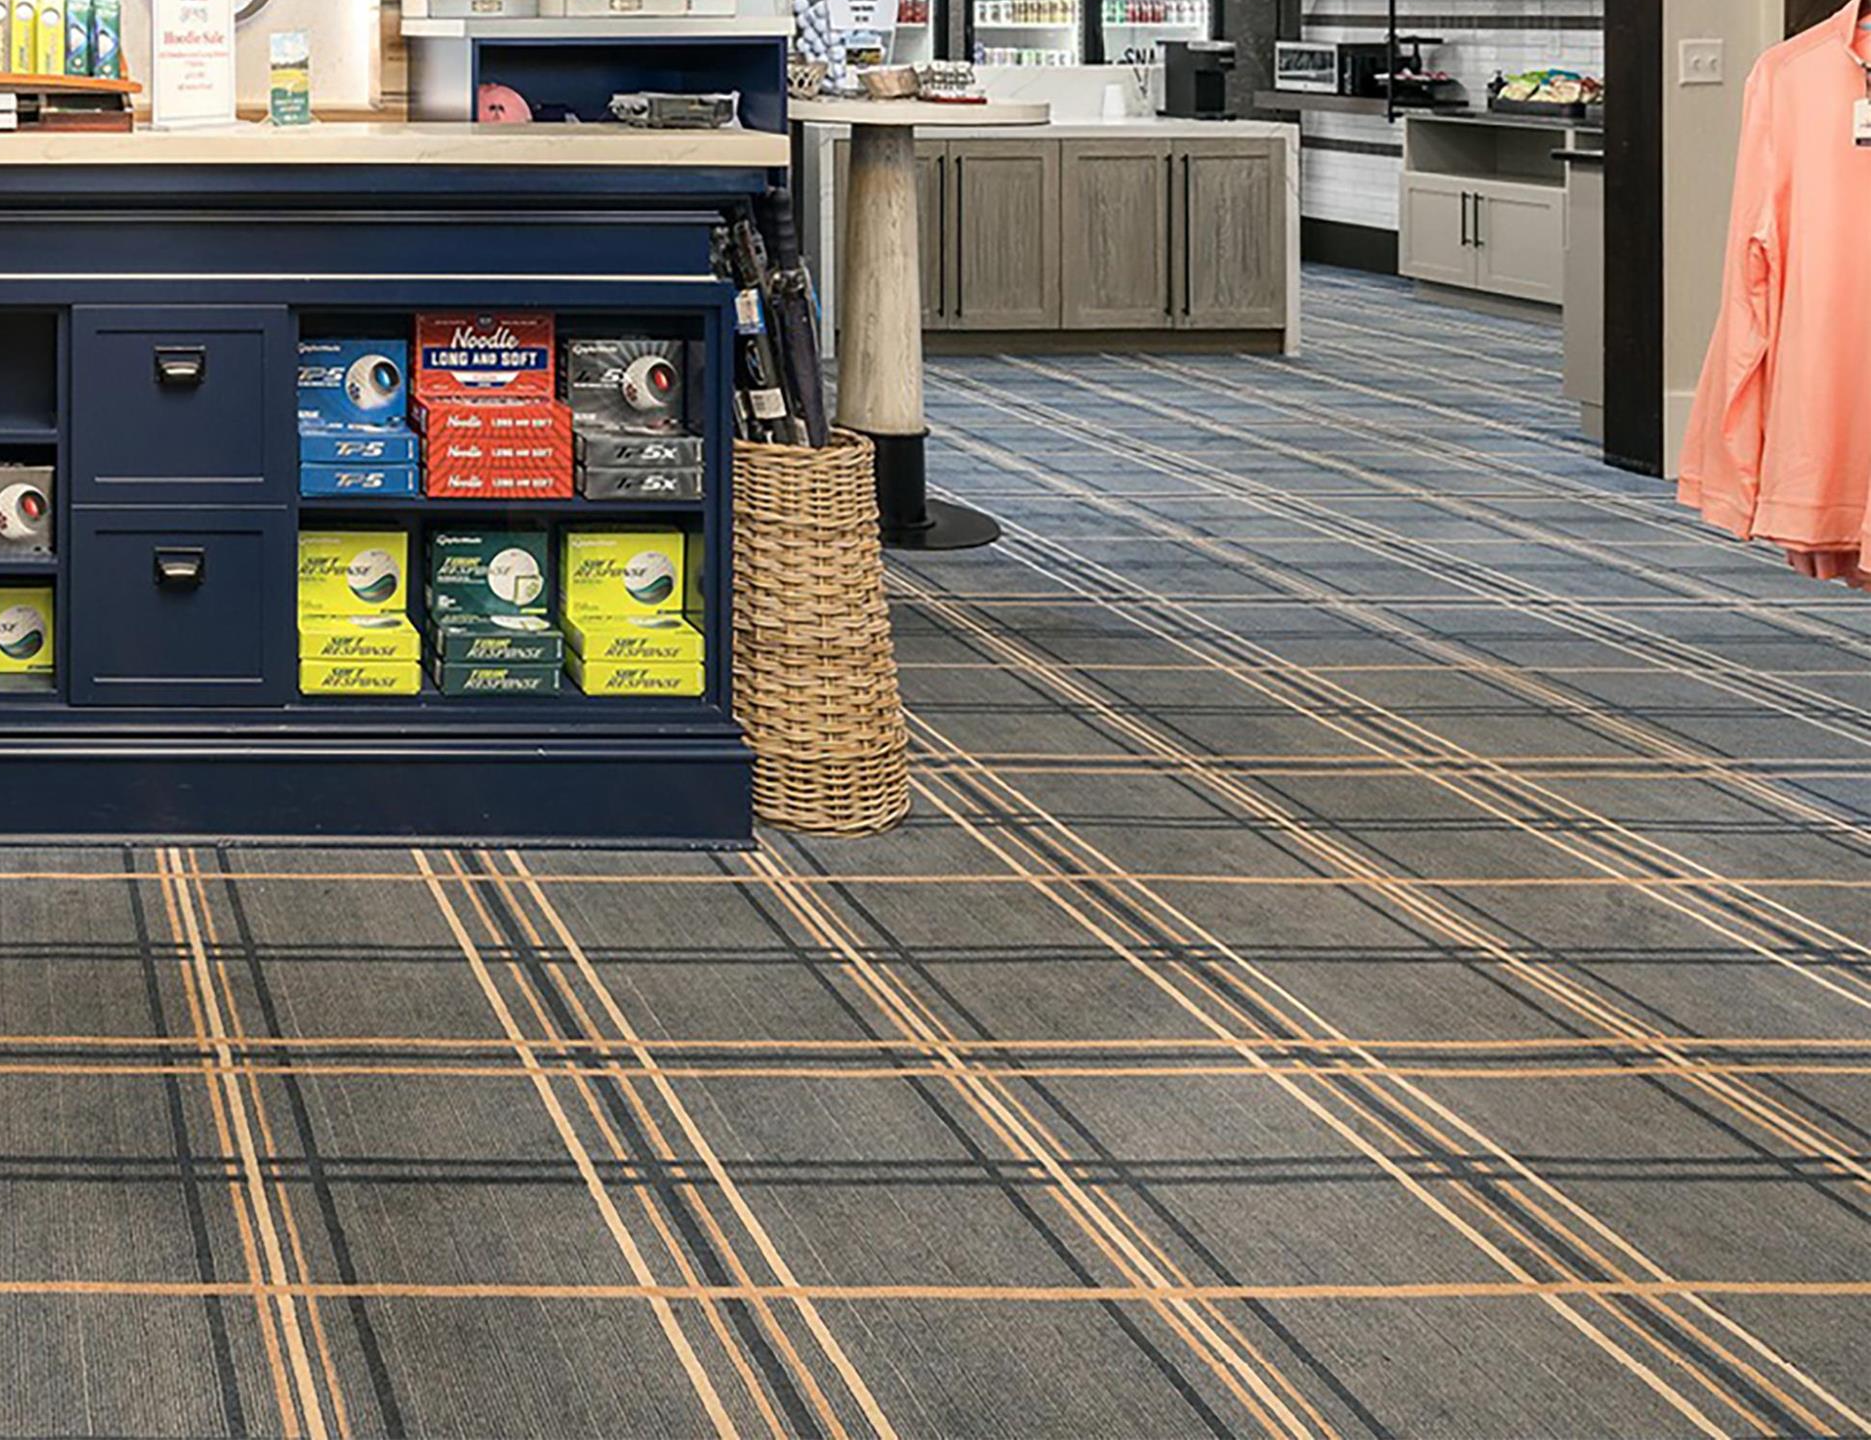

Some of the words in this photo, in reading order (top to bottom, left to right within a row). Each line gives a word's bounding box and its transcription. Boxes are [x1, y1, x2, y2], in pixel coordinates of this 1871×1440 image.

[450, 326, 520, 349] Noodle
[431, 352, 469, 366] LONG
[472, 352, 498, 365] AND
[501, 351, 538, 366] SOFT
